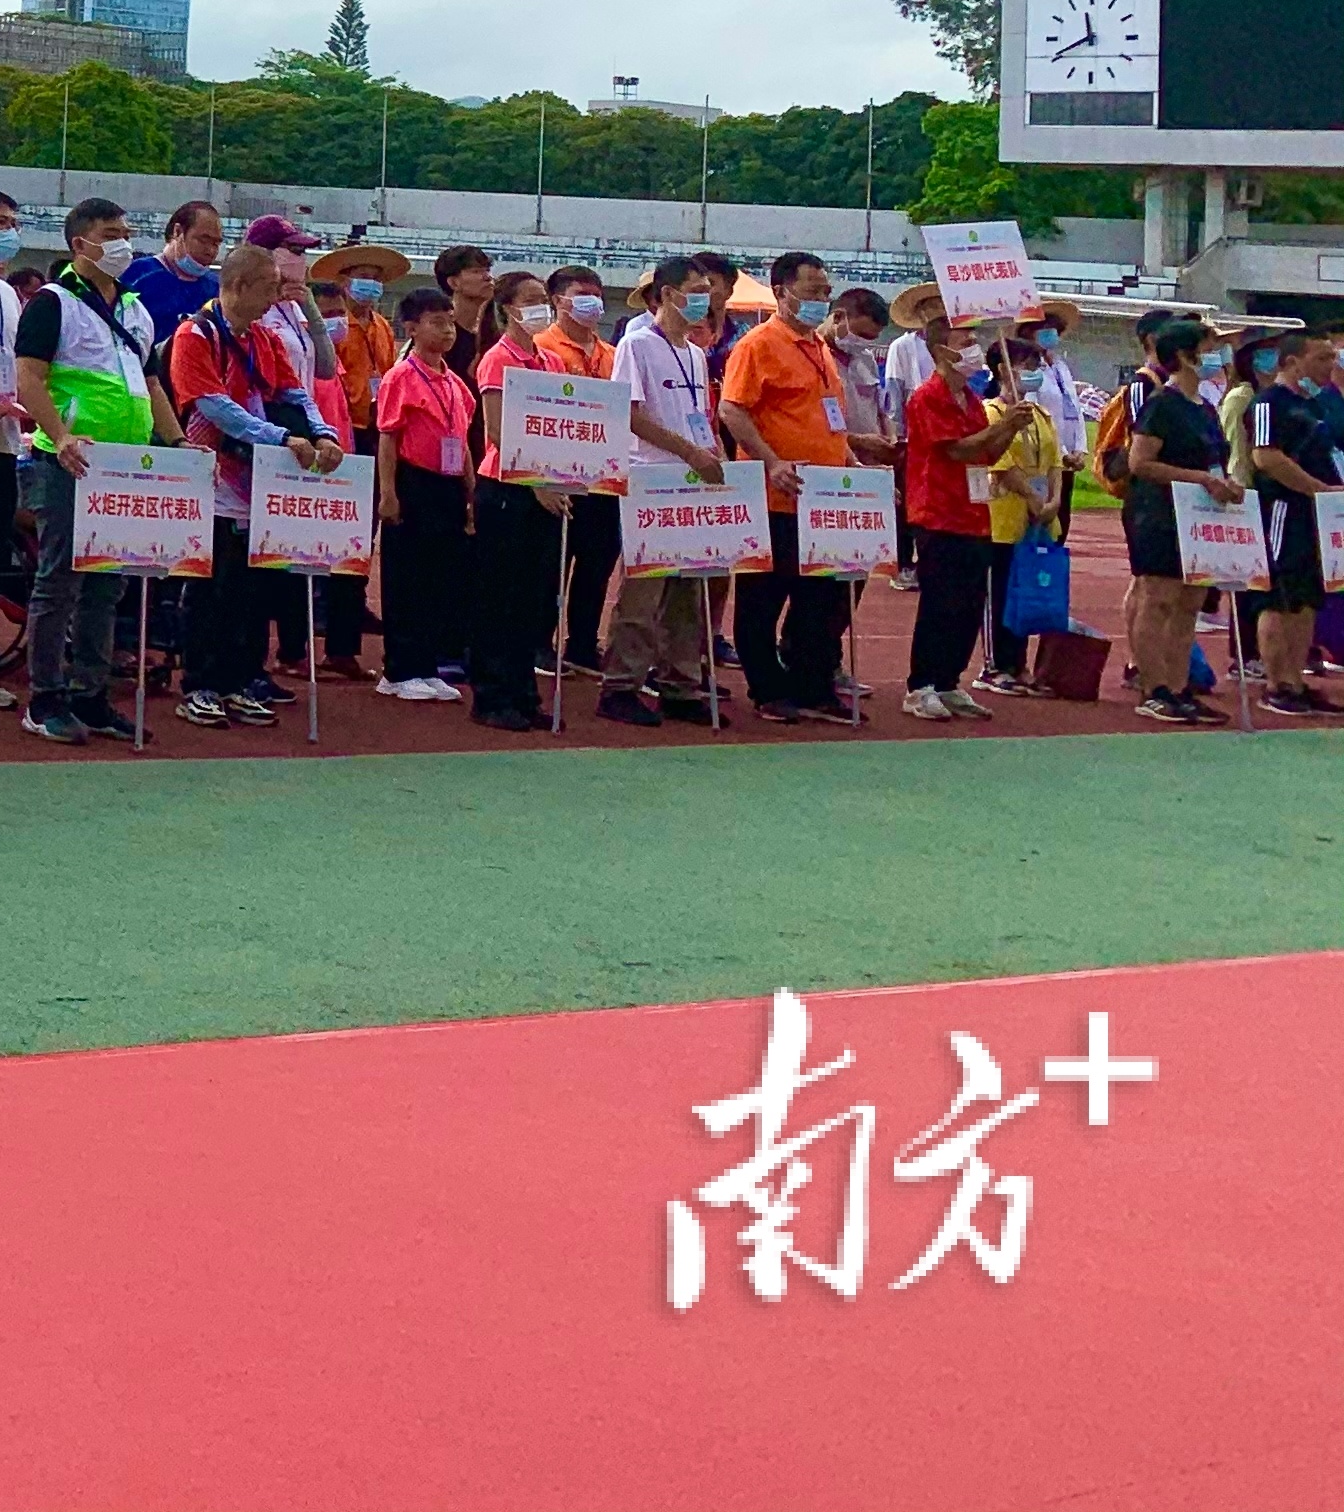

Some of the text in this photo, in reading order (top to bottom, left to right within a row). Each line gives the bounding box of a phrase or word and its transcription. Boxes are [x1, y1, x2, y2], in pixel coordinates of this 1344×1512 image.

[525, 414, 607, 444] 西区代表队
[87, 491, 203, 522] 火炬开发区代表队
[266, 493, 360, 522] 石岐区代表队
[637, 504, 752, 529] 沙溪镇代表队
[809, 508, 886, 531] 横栏镇代表队
